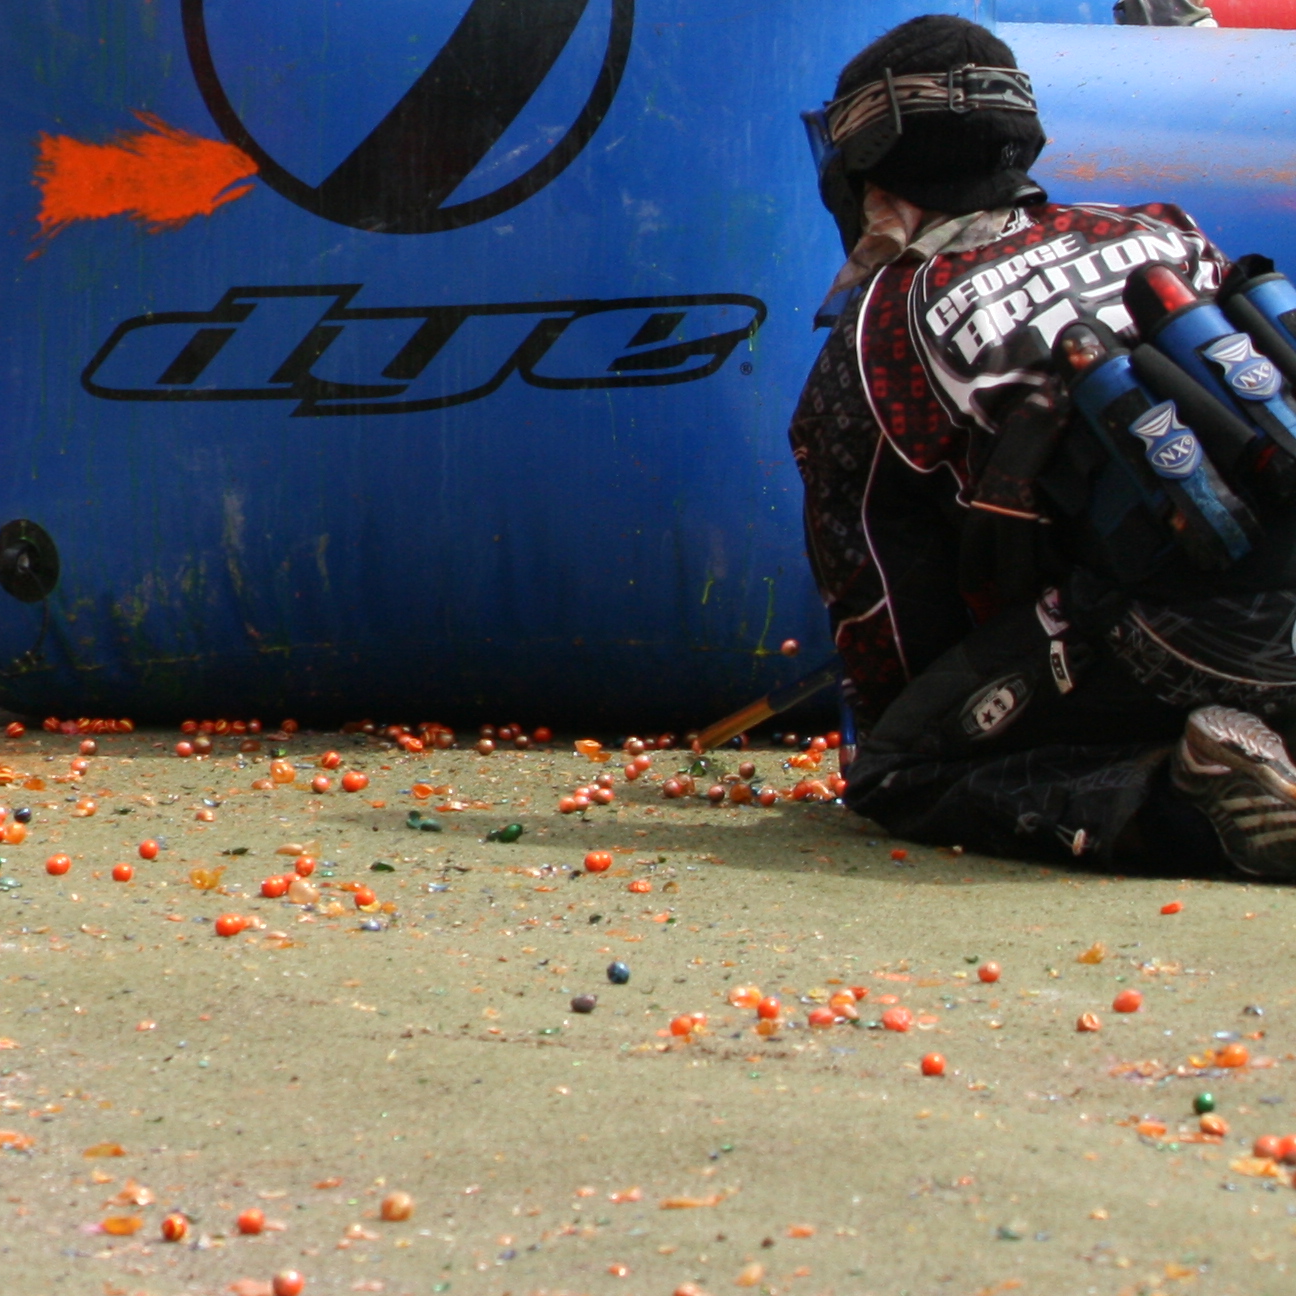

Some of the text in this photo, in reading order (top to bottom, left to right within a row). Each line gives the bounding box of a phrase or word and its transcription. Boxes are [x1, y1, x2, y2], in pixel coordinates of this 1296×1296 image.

[80, 284, 767, 417] dye
[925, 233, 1081, 337] GEORGE
[952, 232, 1187, 365] BRUTON
